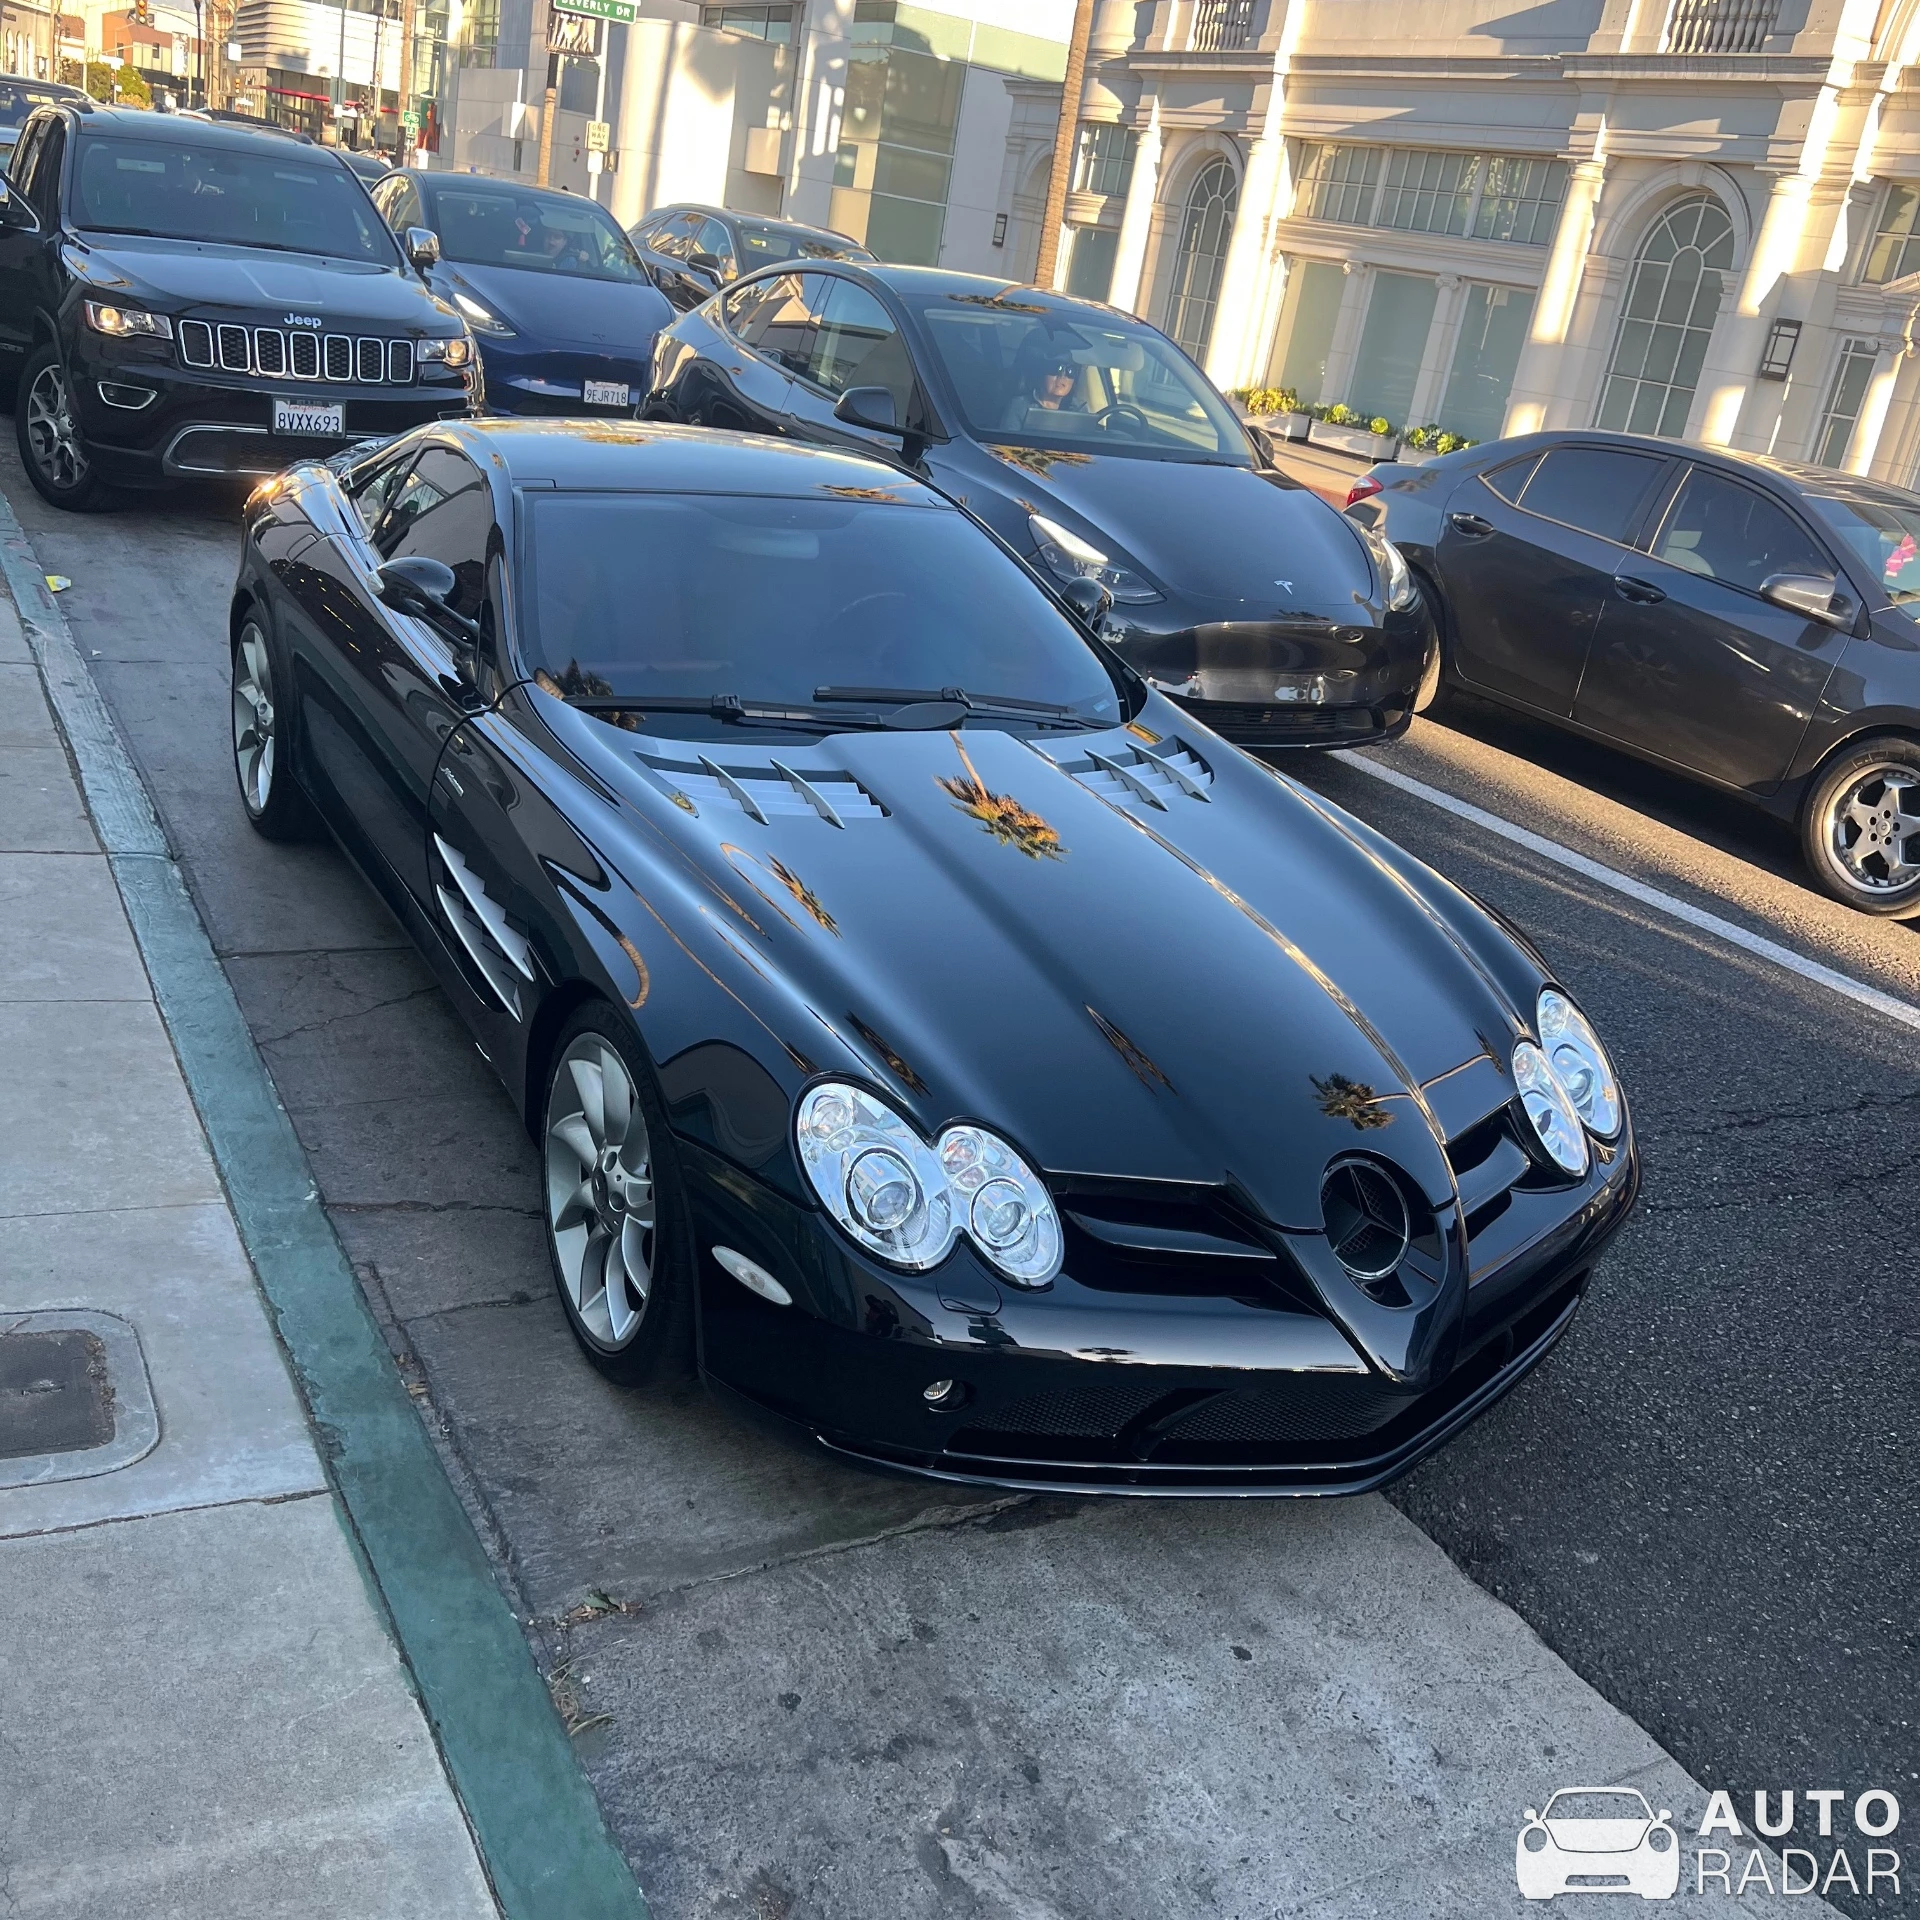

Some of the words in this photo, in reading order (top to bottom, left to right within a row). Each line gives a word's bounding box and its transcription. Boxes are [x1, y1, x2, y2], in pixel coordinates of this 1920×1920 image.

[616, 5, 631, 17] DR
[592, 124, 606, 133] ONE
[284, 313, 322, 328] Jeep
[586, 389, 627, 404] 9EJR718
[278, 412, 340, 432] 8VXX693
